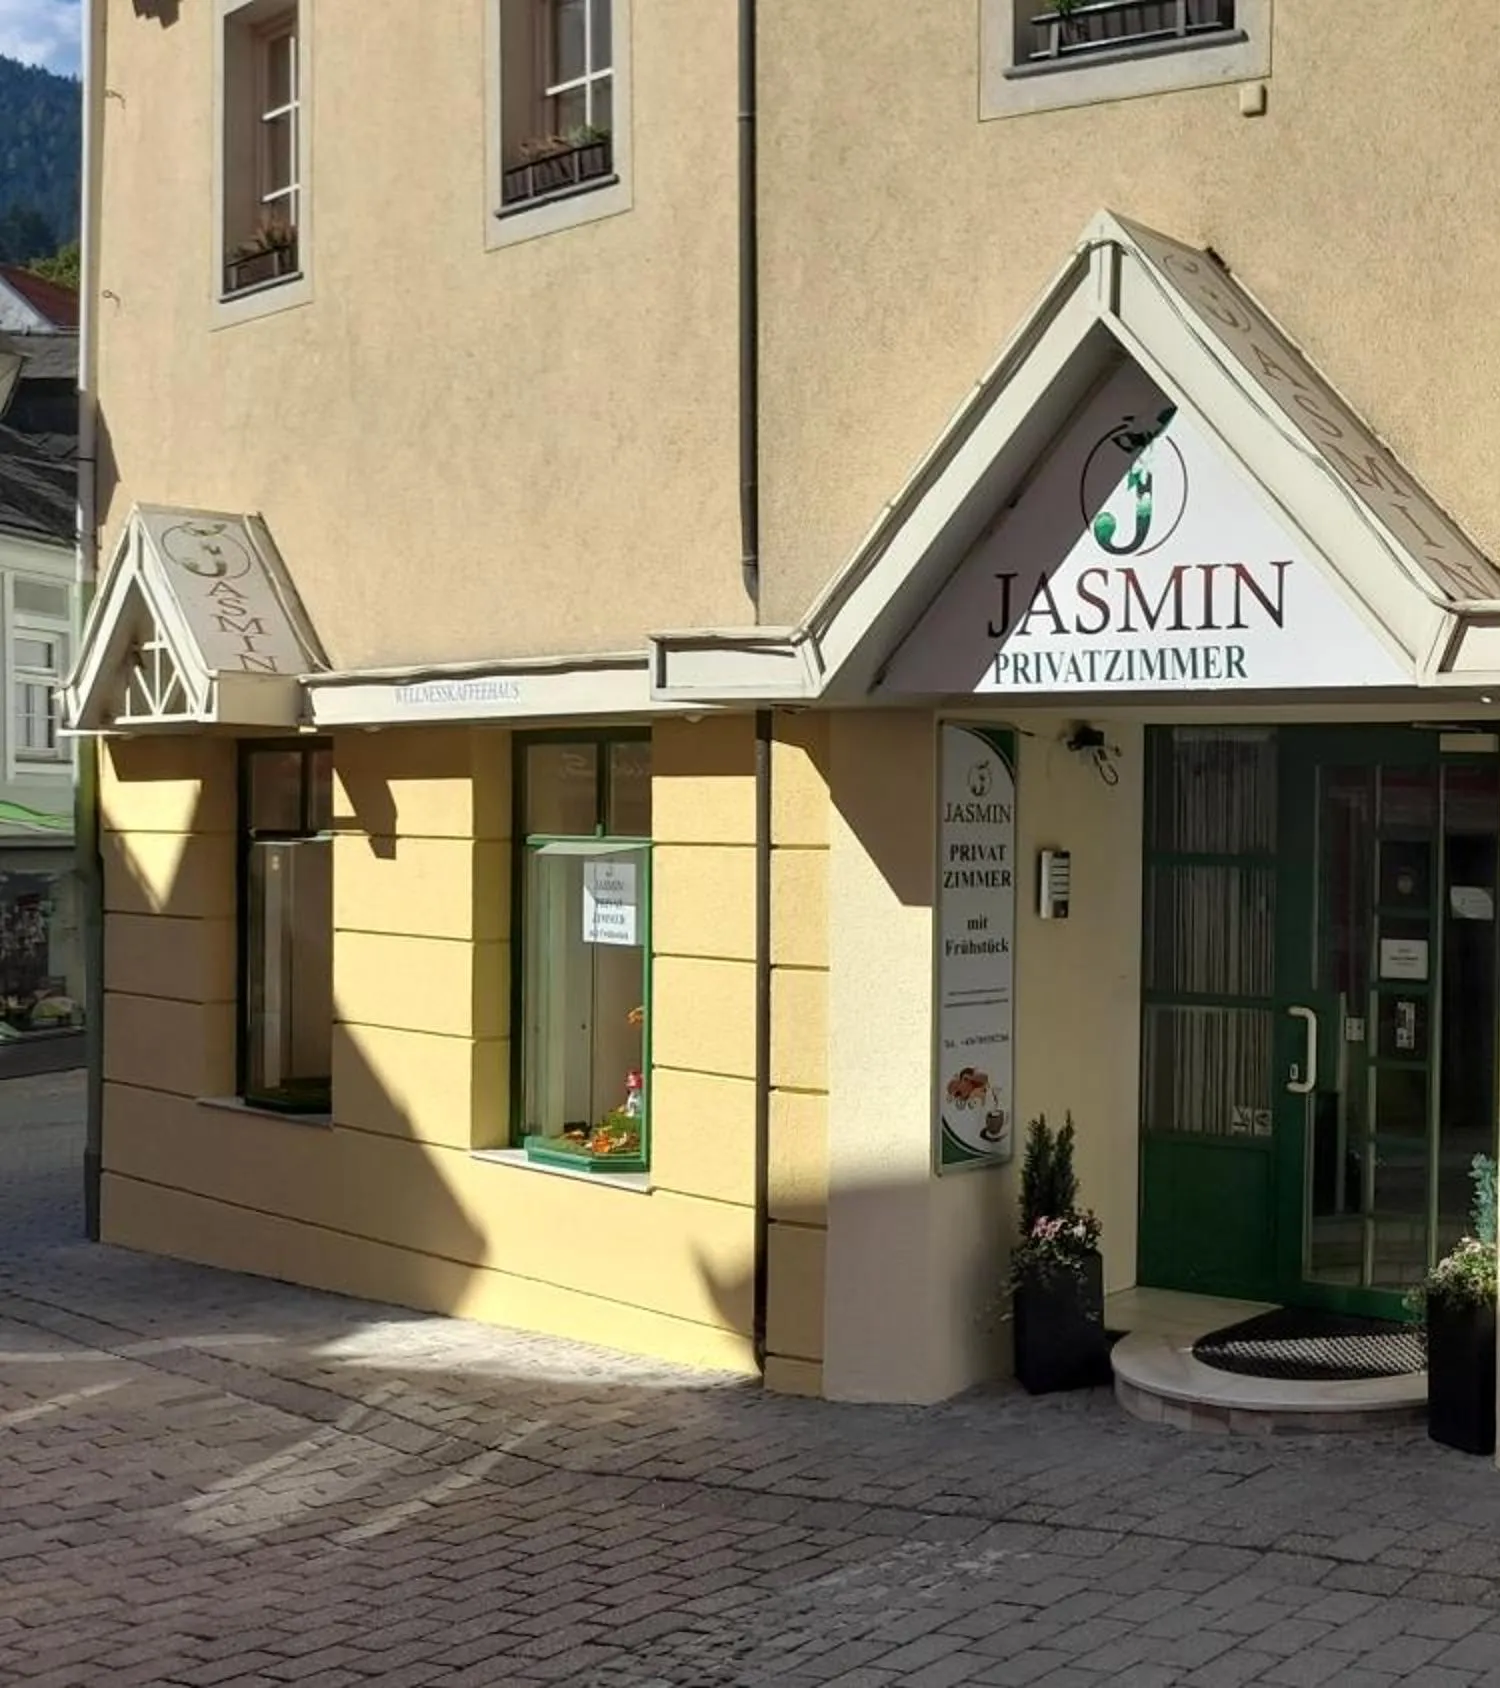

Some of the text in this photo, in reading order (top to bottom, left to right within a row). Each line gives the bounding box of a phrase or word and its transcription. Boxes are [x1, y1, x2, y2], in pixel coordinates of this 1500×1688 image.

[988, 560, 1293, 638] JASMIN
[994, 645, 1248, 685] PRIVATZIMMER
[944, 803, 1011, 824] JASMIN
[950, 844, 1007, 862] PRIVAT
[944, 870, 1012, 889] ZIMMER
[967, 914, 988, 930] mit
[945, 937, 1009, 956] Frühstück
